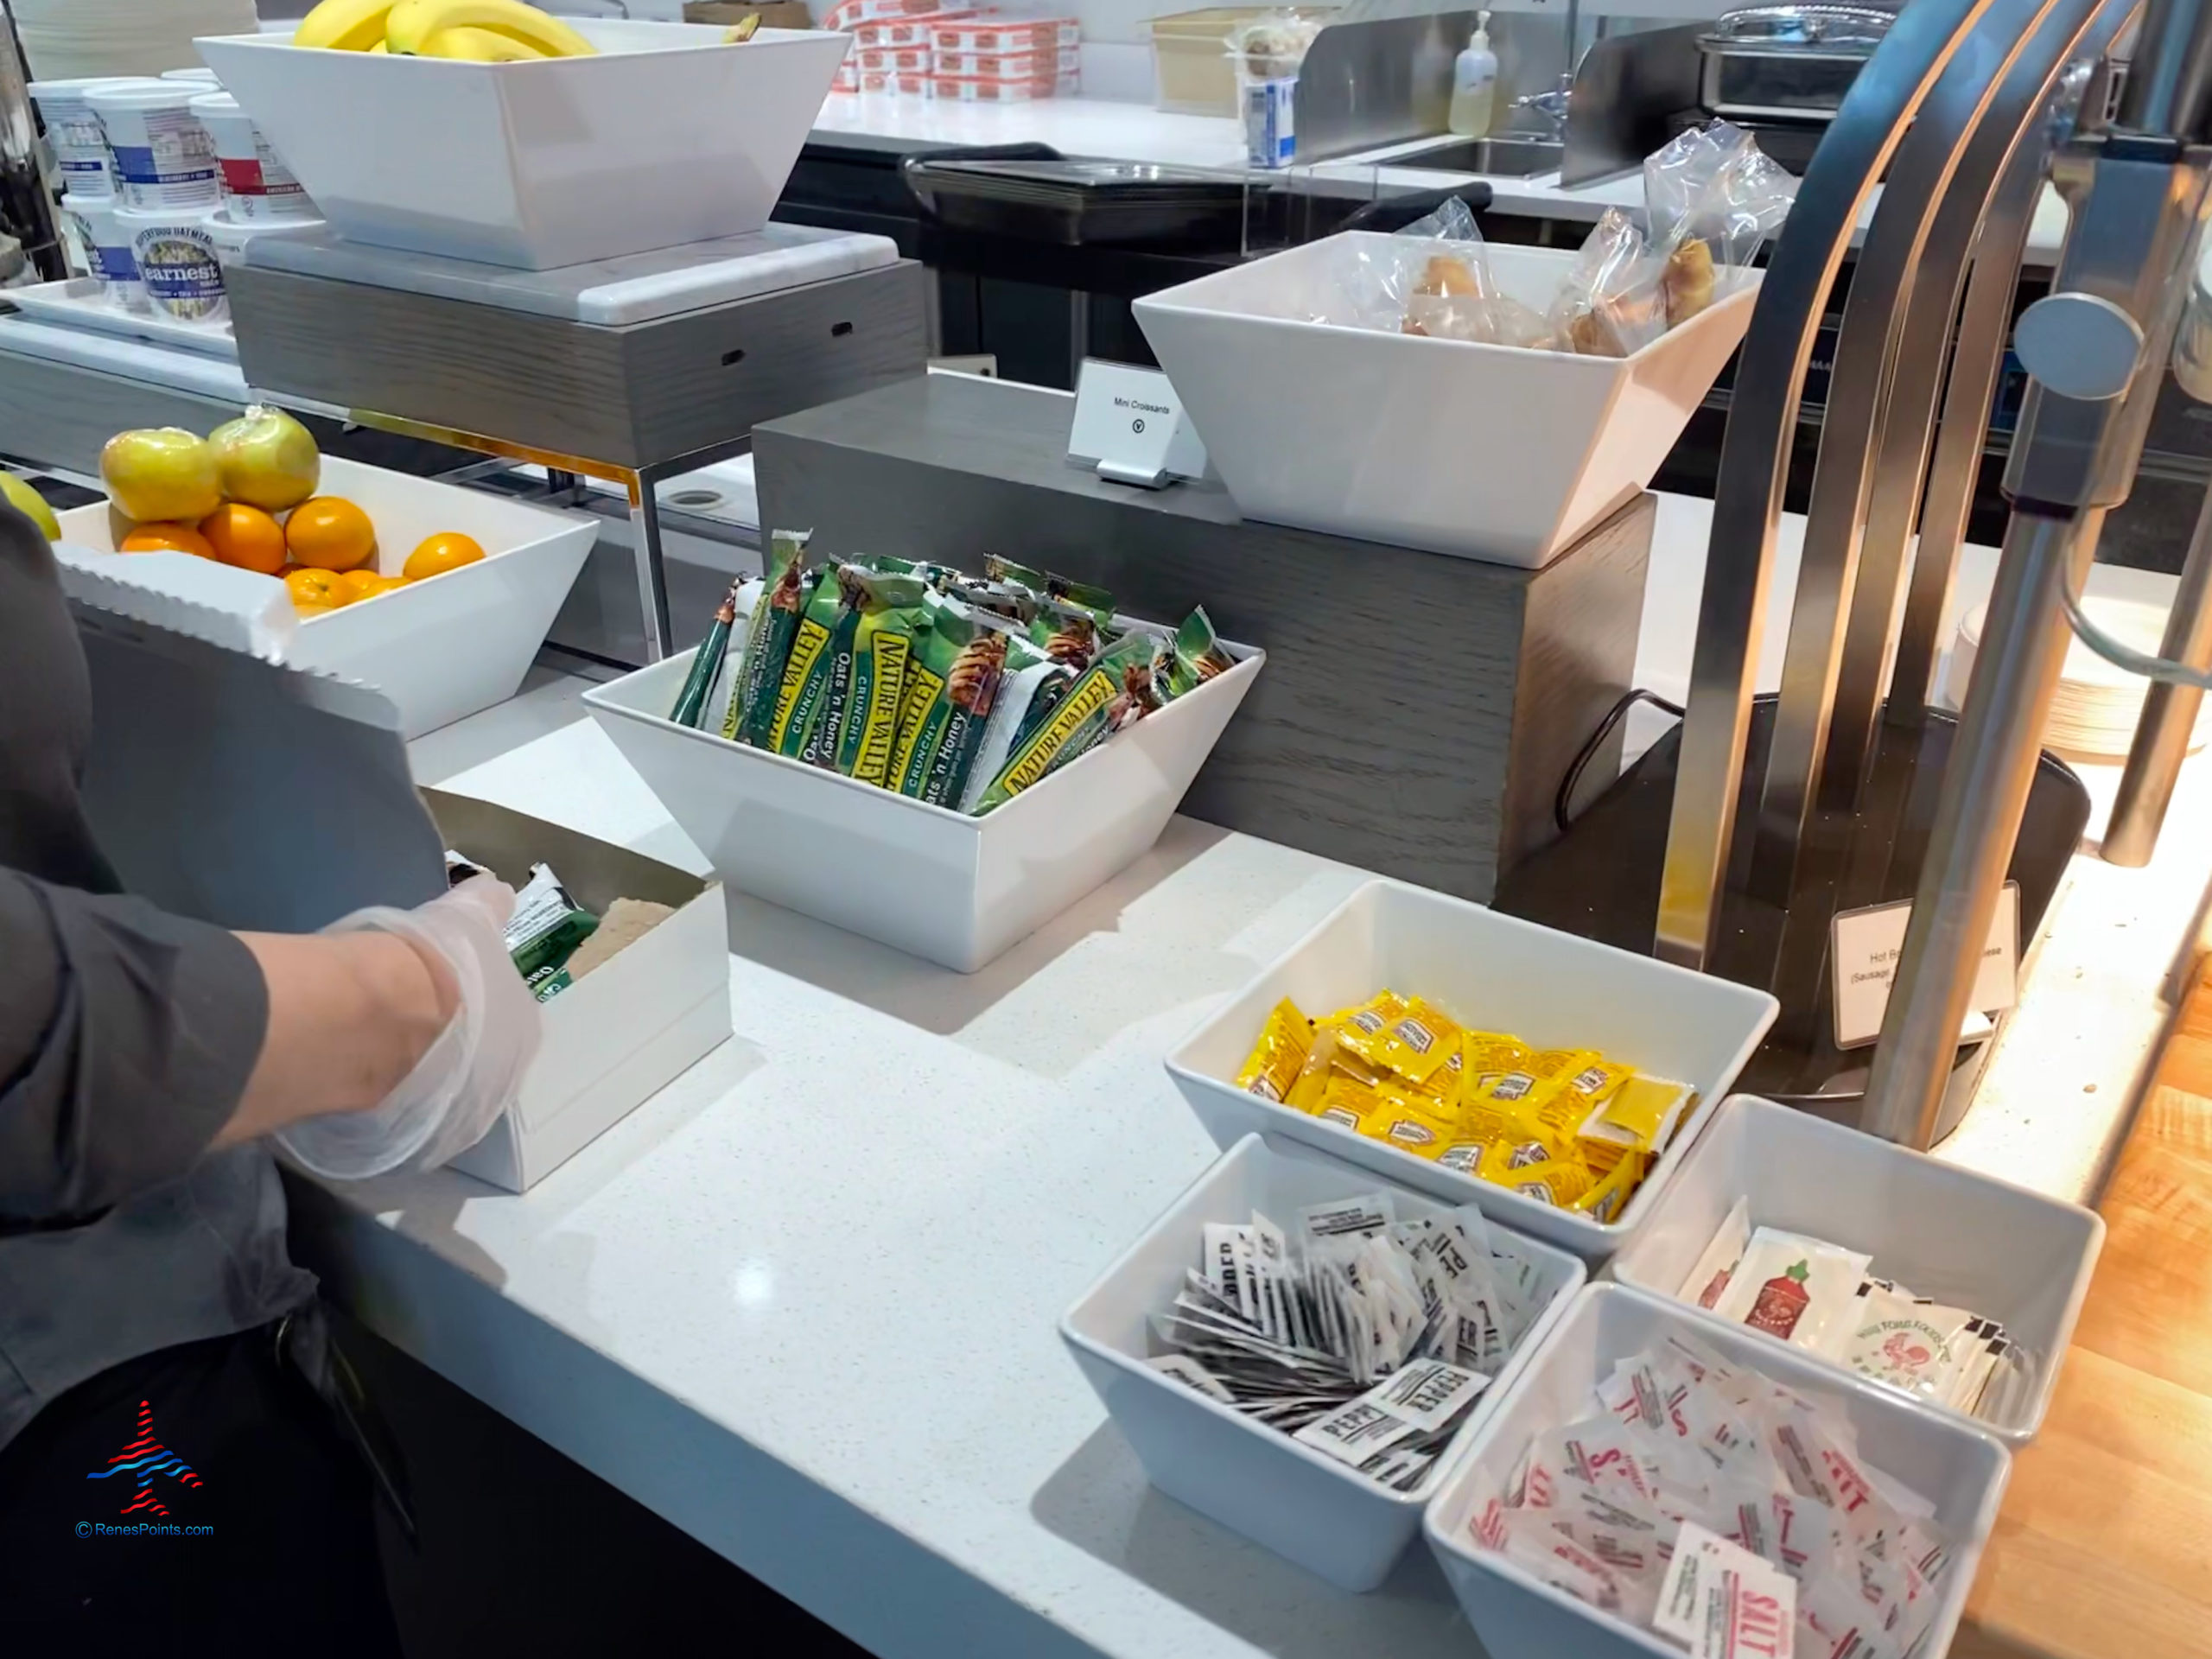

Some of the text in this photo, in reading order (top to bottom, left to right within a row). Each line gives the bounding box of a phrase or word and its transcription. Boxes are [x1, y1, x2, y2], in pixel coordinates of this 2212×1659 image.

[145, 263, 218, 282] earnest
[1114, 397, 1170, 415] Mini Croissants
[785, 622, 825, 689] VALLEY
[835, 652, 852, 689] Oats
[876, 639, 906, 718] NATURE
[791, 671, 823, 734] CRUNCHY
[832, 694, 847, 708] 'n
[849, 675, 868, 744] CRUNCHY
[901, 674, 938, 747] VALLEY
[1010, 674, 1109, 793] NATURE VALLEY
[822, 711, 842, 760] Honey
[908, 721, 938, 788] CRUNCHY
[925, 782, 941, 804] ats
[938, 711, 967, 761] Honey
[1870, 951, 1887, 963] Hot
[1407, 1370, 1470, 1412] PEPPER
[1739, 1590, 1780, 1658] SALT
